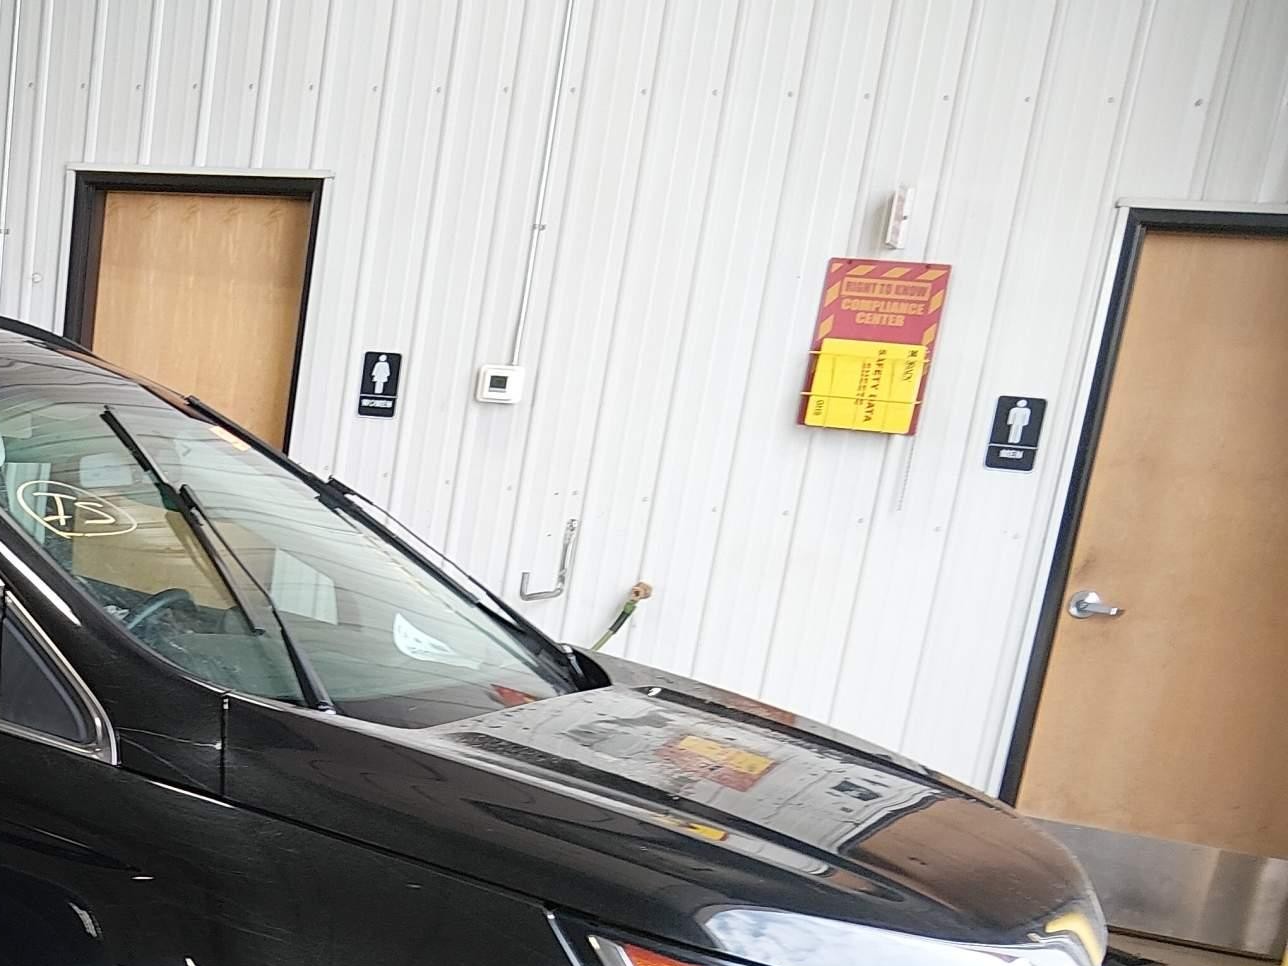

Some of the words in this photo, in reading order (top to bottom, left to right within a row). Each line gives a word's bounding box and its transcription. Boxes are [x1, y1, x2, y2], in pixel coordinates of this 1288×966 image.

[879, 282, 891, 295] TO
[841, 298, 926, 316] COMPLIANCE
[855, 311, 906, 327] CENTER
